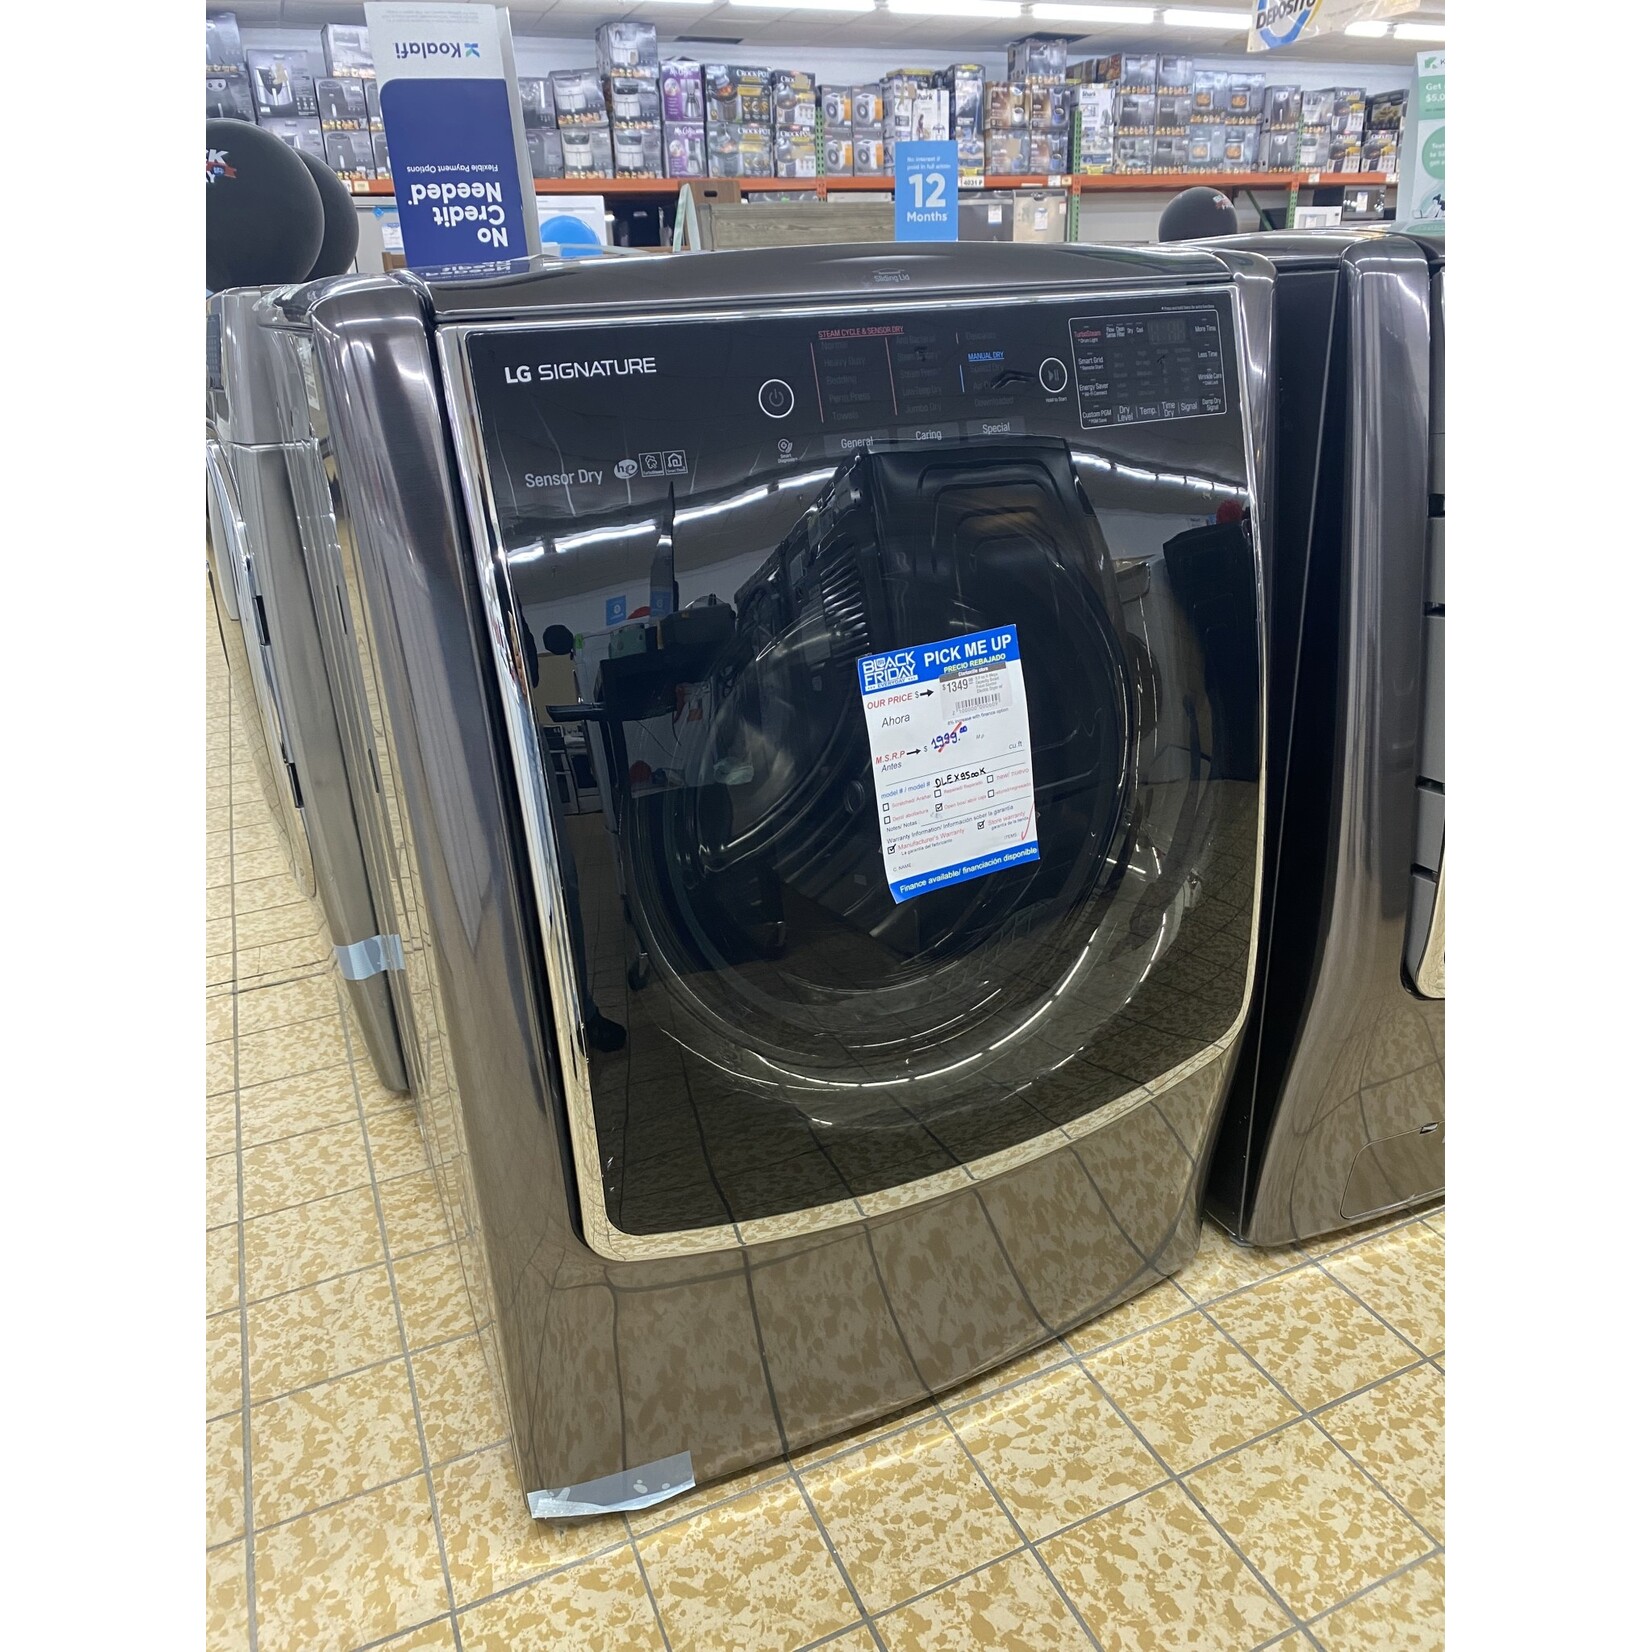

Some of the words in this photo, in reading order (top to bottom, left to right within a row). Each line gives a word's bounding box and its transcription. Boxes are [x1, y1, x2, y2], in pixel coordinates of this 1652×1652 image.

[394, 41, 462, 59] Koalafi
[1425, 83, 1441, 91] Get
[406, 163, 437, 175] Options
[437, 163, 470, 174] Payment
[471, 164, 499, 174] Flexible
[408, 181, 502, 205] Needed
[908, 172, 947, 208] 12
[432, 204, 506, 228] Credit
[906, 211, 948, 223] Months
[476, 226, 509, 248] No
[873, 275, 899, 283] Sliding
[818, 330, 841, 338] STEAM
[841, 328, 861, 337] CYCLE
[867, 326, 892, 335] SENSOR
[892, 325, 904, 333] DRY
[968, 352, 992, 360] MANUAL
[992, 351, 1004, 359] DRY
[504, 365, 532, 384] LG
[537, 357, 657, 381] SIGNATURE
[1119, 405, 1130, 415] Dry
[1139, 406, 1157, 417] Temp.
[1161, 401, 1175, 409] Time
[1180, 401, 1198, 412] Signal
[1117, 413, 1134, 422] Level
[1163, 408, 1175, 418] Dry
[982, 421, 1011, 435] Special
[915, 429, 942, 441] Caring
[840, 436, 874, 449] General
[524, 472, 575, 488] Sensor
[578, 468, 603, 486] Dry
[924, 645, 961, 668] PICK
[964, 640, 987, 658] ME
[990, 634, 1012, 651] UP
[862, 651, 916, 674] BLACK
[943, 662, 969, 673] PRECIO
[969, 653, 1006, 667] REBAJADO
[864, 663, 916, 686] FRIDAY
[877, 677, 906, 688] EVERYDAY
[867, 699, 886, 710] OUR
[887, 692, 913, 706] PRICE
[996, 707, 1009, 715] option
[881, 713, 911, 728] Ahora
[875, 750, 906, 765] M.S.R.P
[923, 745, 928, 753] $
[881, 762, 902, 773] Antes
[1010, 768, 1030, 777] nuevo
[881, 788, 899, 799] model
[908, 782, 926, 792] model
[886, 833, 911, 844] Warranty
[911, 825, 942, 838] Information/
[943, 817, 973, 830] Información
[973, 812, 987, 821] sober
[994, 804, 1014, 816] garantía
[987, 817, 1003, 826] Store
[1003, 811, 1026, 823] warranty
[886, 824, 902, 832] Notes/
[903, 820, 918, 829] Notas
[898, 834, 940, 850] Manufacturer's
[939, 828, 965, 840] Warranty
[1003, 832, 1018, 840] ITEMS
[898, 863, 912, 871] NAME
[900, 880, 928, 894] Finance
[928, 869, 962, 885] available/
[962, 857, 1002, 875] financiación
[1003, 846, 1038, 863] disponible
